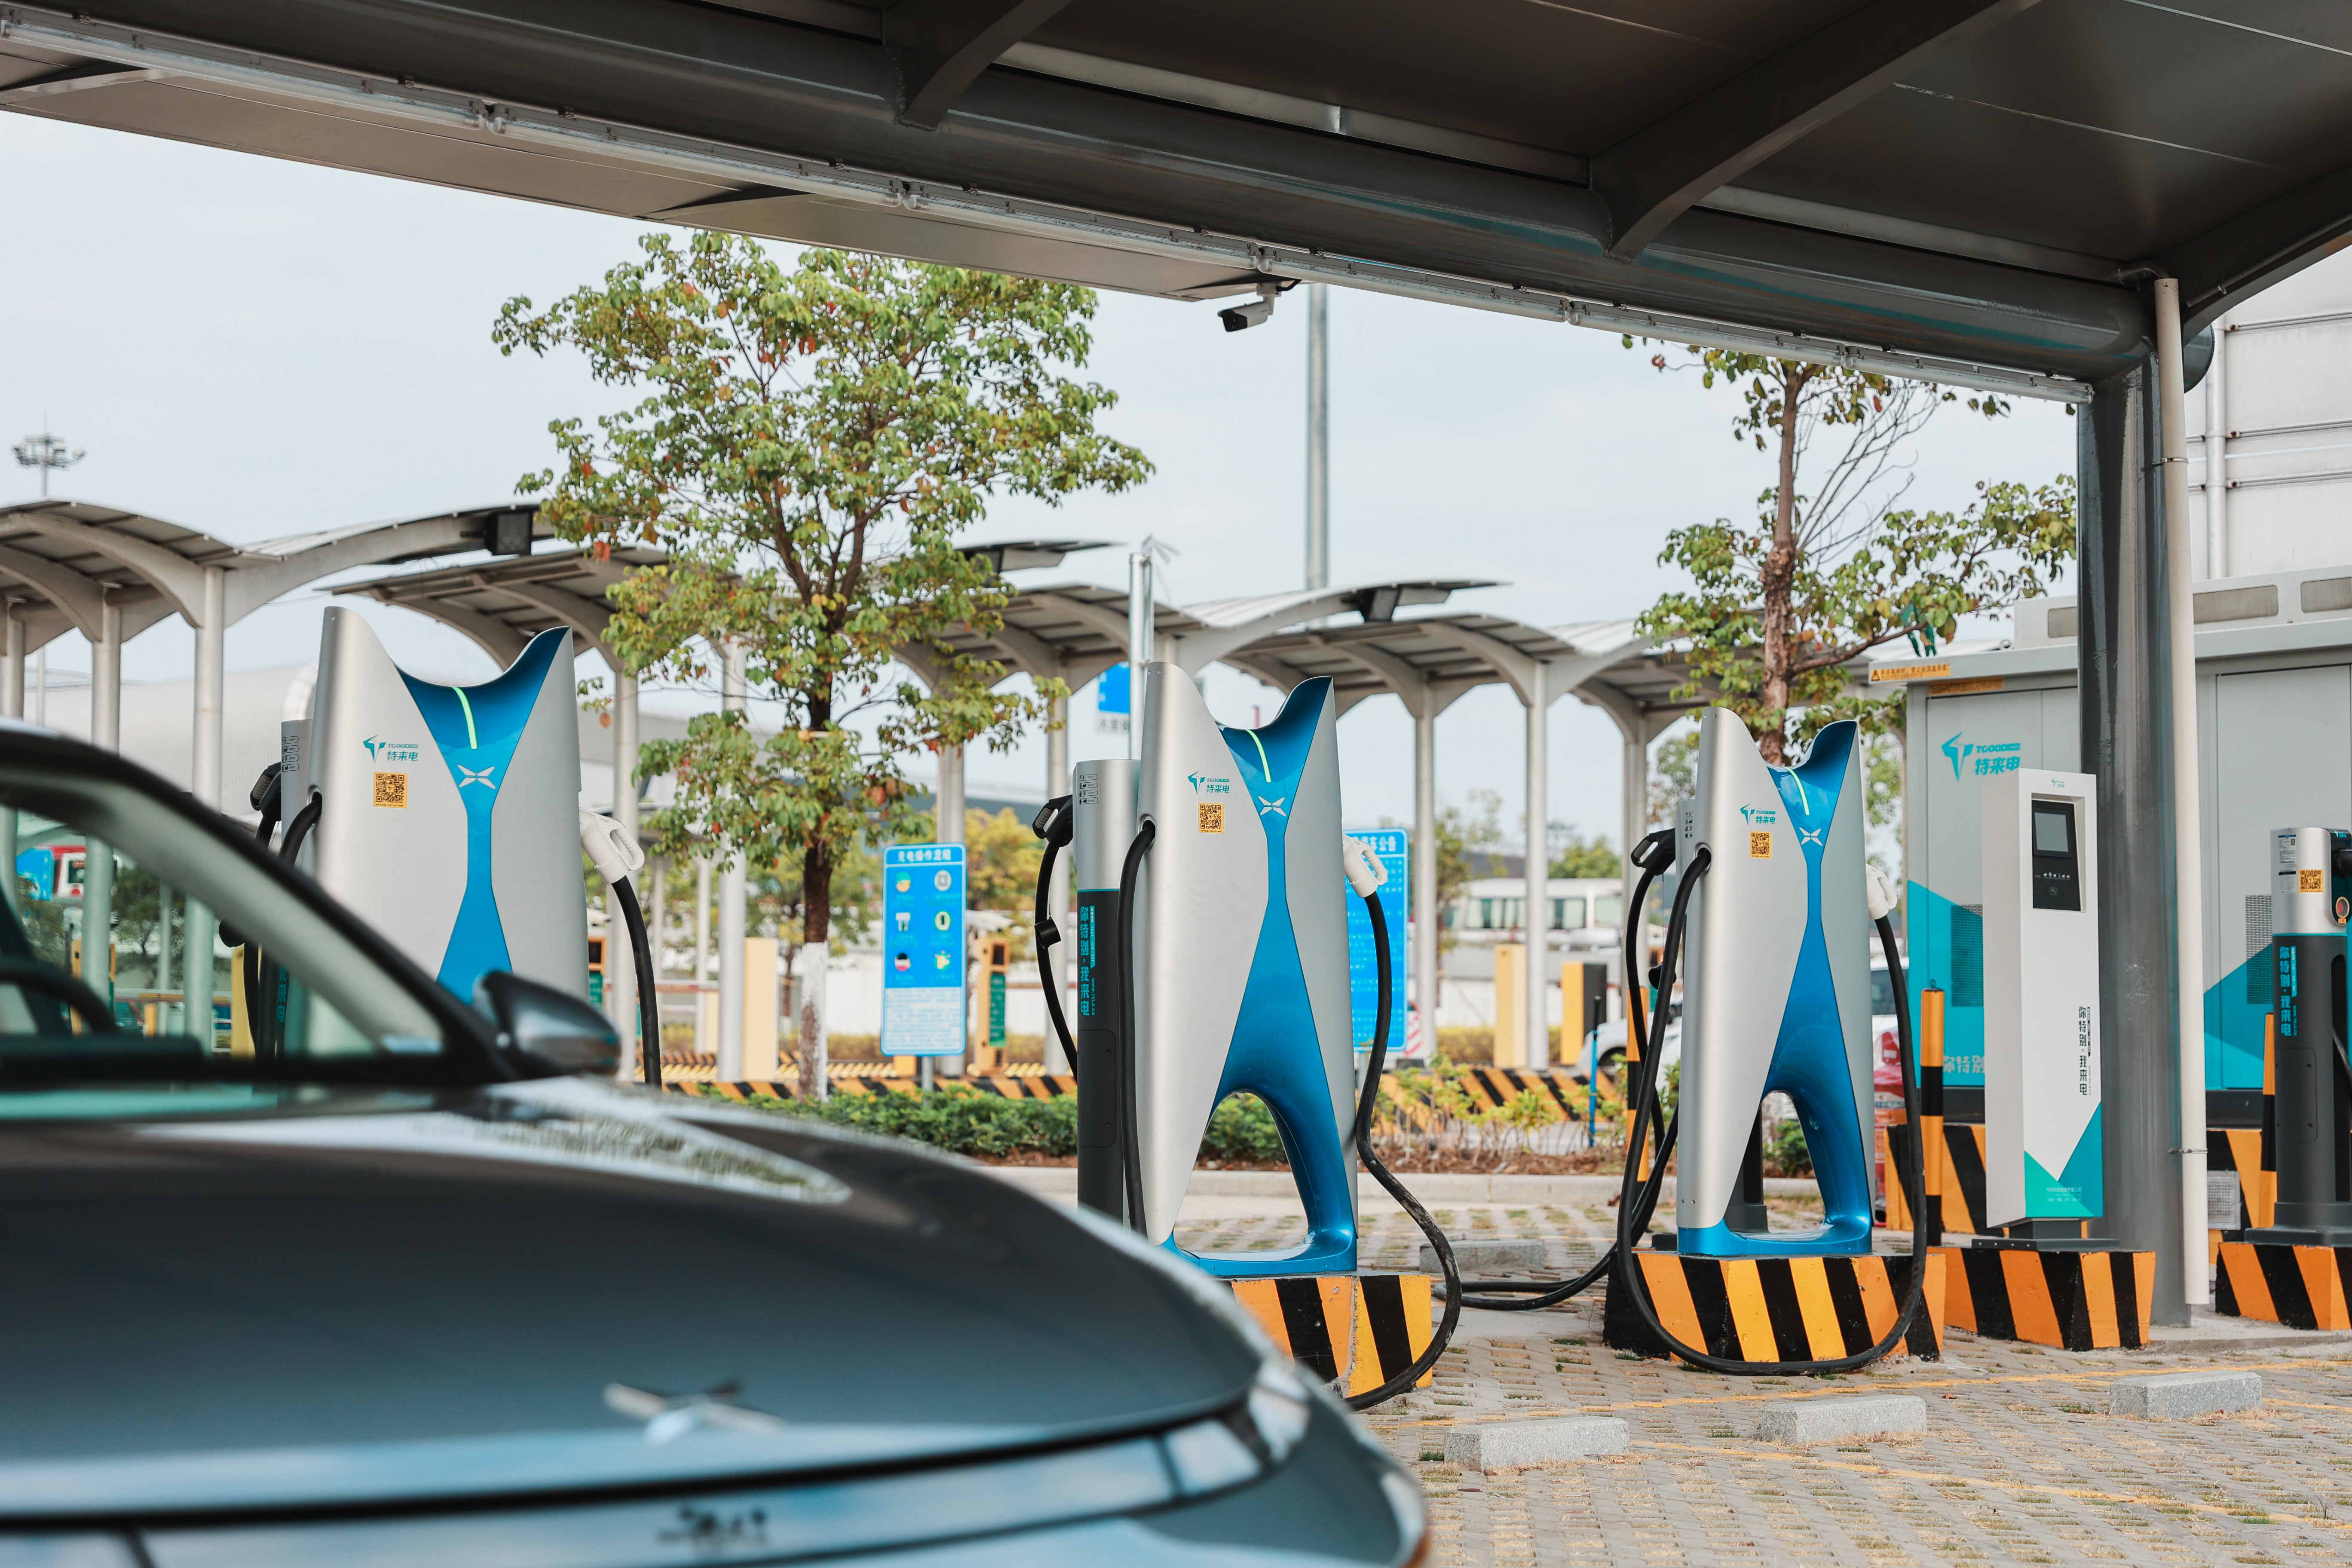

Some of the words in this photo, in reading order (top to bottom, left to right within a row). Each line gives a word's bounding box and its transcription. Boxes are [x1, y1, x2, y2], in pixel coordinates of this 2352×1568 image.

[1976, 744, 2006, 753] TGOOD
[387, 751, 418, 761] 特来电
[1206, 784, 1230, 793] 特来电
[1756, 816, 1776, 824] 特来电
